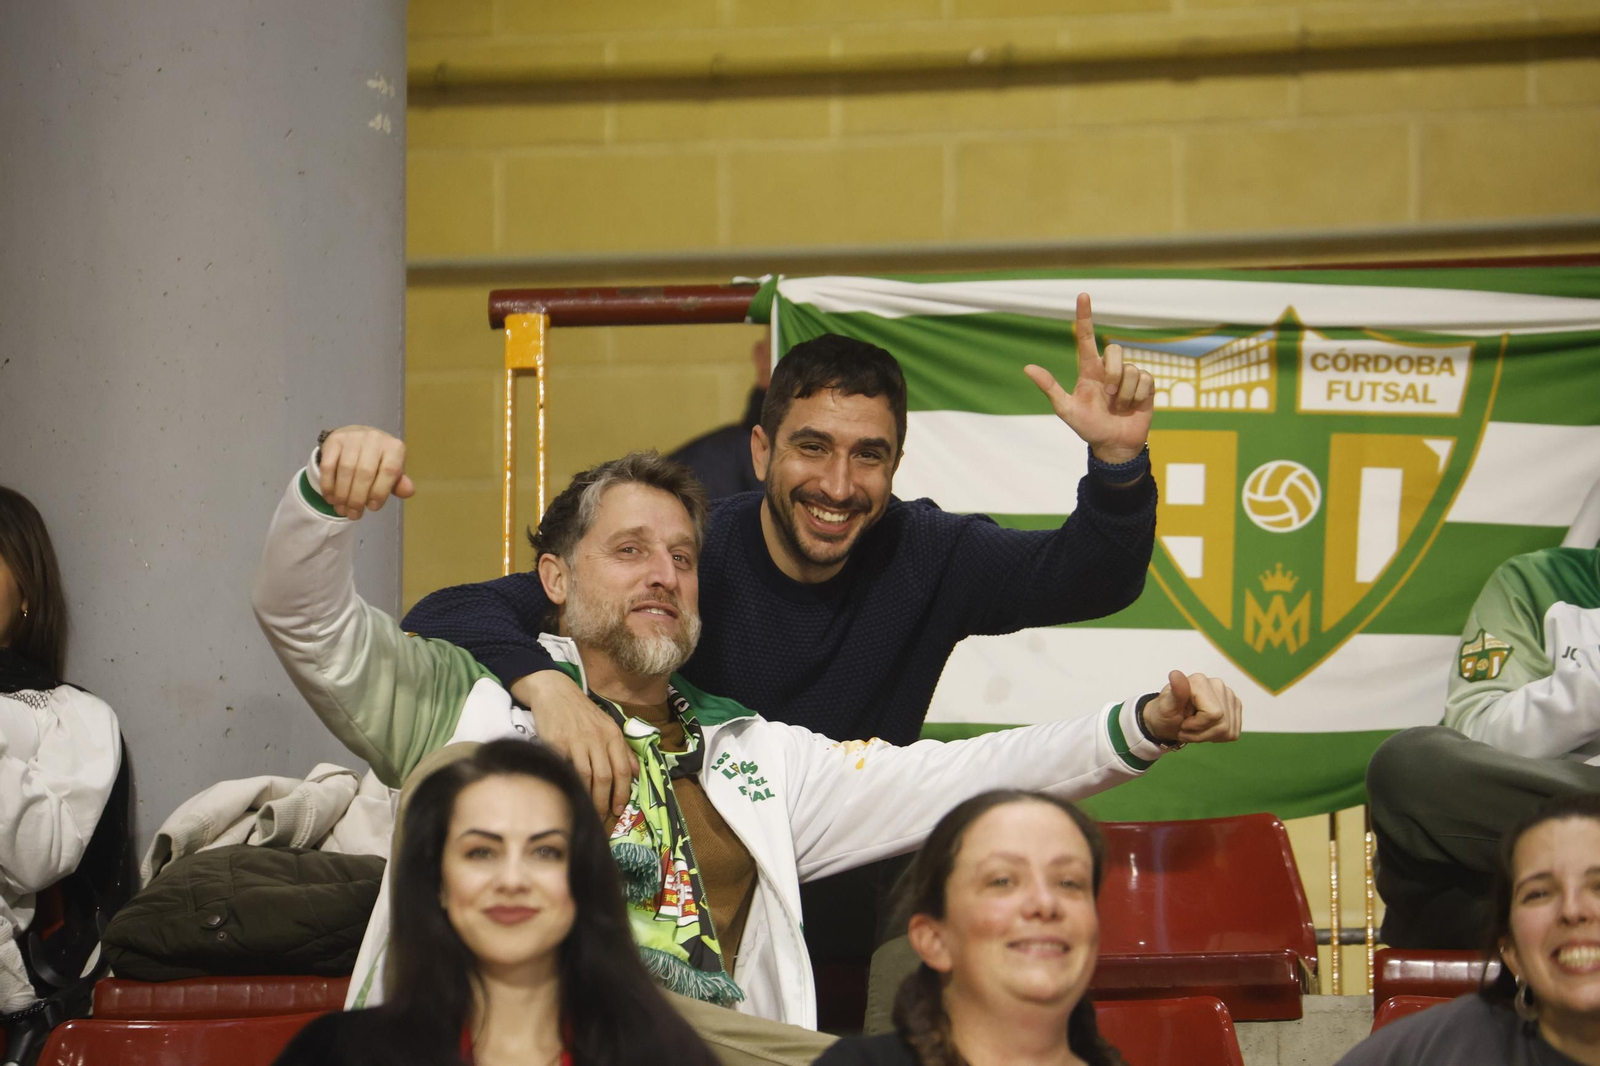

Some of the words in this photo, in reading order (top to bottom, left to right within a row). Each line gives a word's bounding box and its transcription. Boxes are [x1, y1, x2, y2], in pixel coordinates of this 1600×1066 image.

[1310, 347, 1456, 377] CÓRDOBA
[1326, 379, 1437, 404] FUTSAL
[710, 751, 731, 771] LOS
